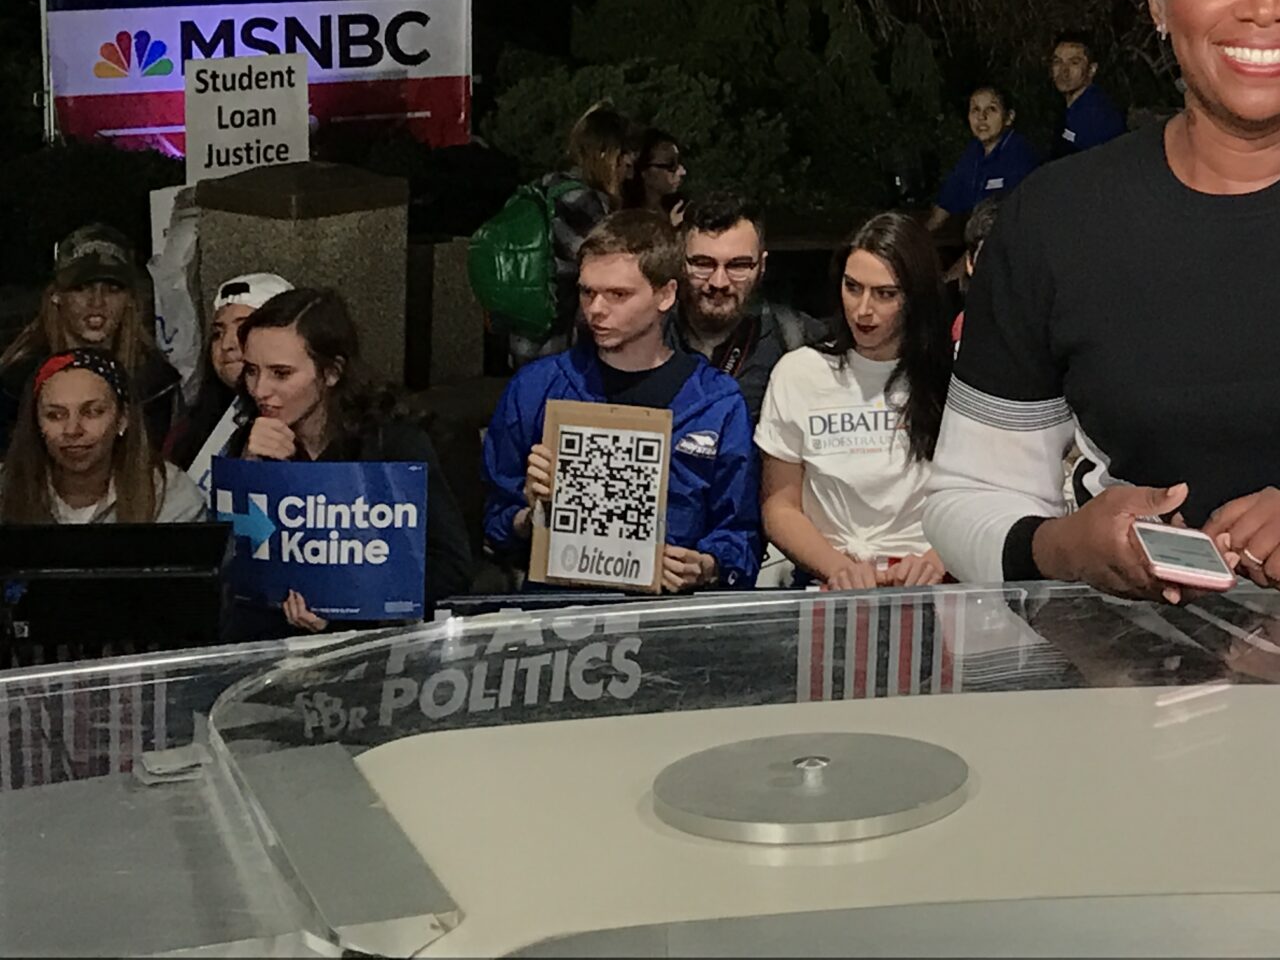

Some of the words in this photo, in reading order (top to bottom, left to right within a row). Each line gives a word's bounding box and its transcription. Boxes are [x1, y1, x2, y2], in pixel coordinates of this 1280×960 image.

[179, 10, 431, 76] MSNBC
[195, 65, 295, 94] Student
[217, 105, 276, 129] Loan
[204, 140, 289, 169] Justice
[809, 411, 896, 436] DEBATE
[277, 495, 417, 529] Clinton
[281, 531, 389, 565] Kaine
[578, 544, 641, 579] bitcoin
[379, 638, 642, 727] POLITICS
